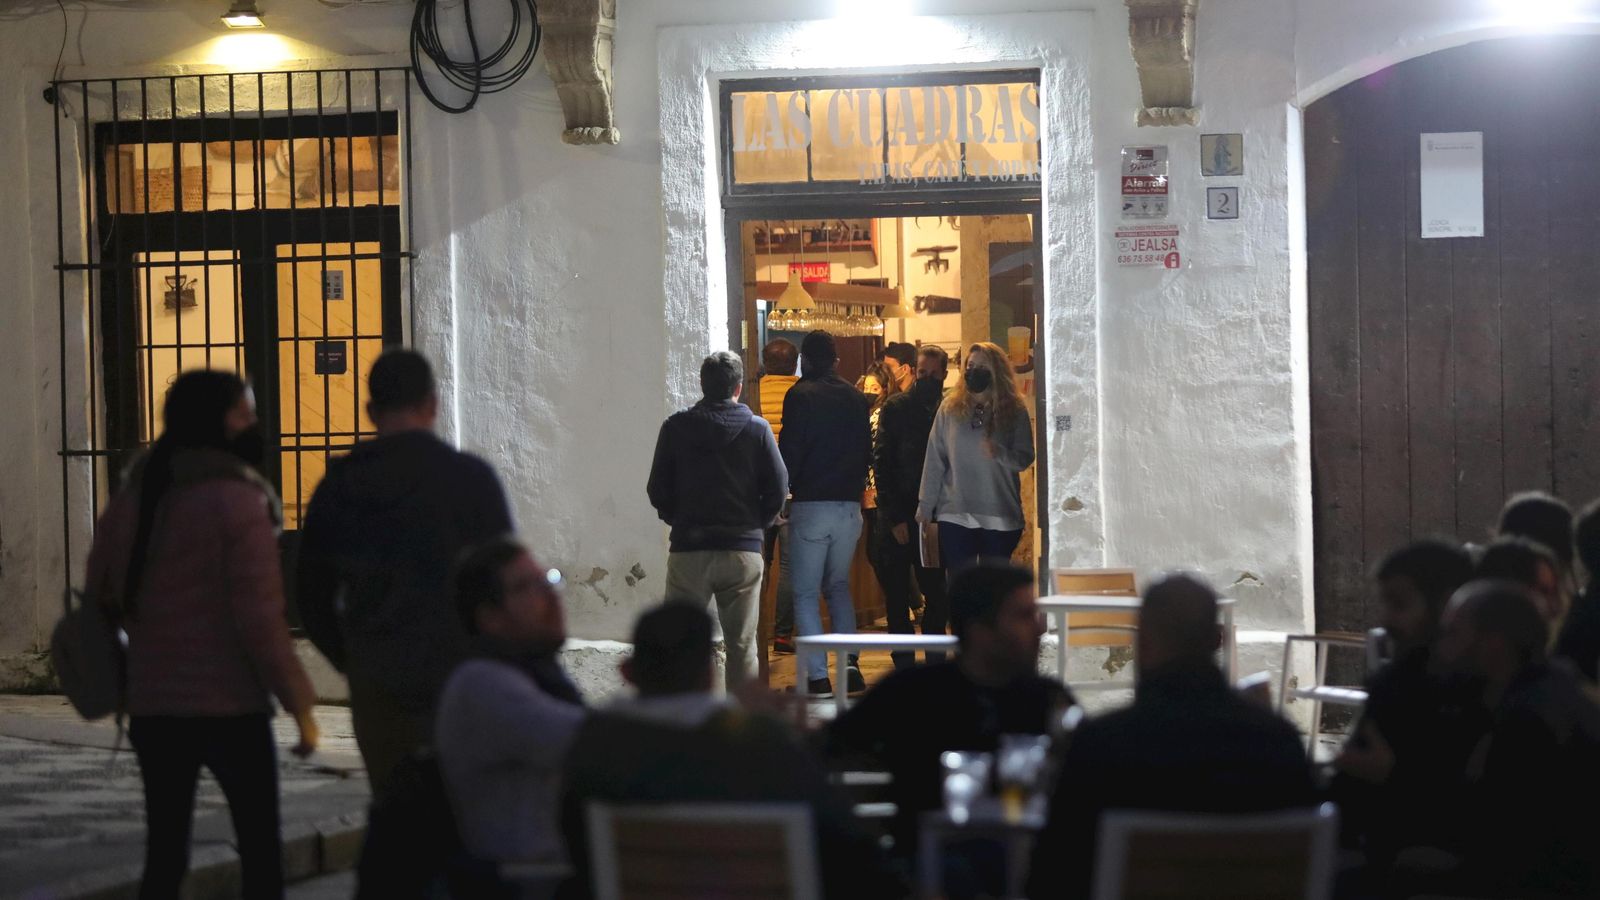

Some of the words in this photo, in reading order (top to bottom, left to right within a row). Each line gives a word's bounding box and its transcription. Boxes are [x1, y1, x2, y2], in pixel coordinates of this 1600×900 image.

[732, 91, 811, 151] LAS
[827, 84, 1041, 148] CUADRAS
[923, 154, 968, 183] CAFÉ
[1124, 178, 1167, 188] Alarma
[1217, 192, 1230, 214] 2
[1131, 238, 1178, 252] JEALSA
[1117, 255, 1131, 264] 636
[1133, 255, 1143, 263] 75
[1145, 254, 1154, 263] 58
[1155, 253, 1165, 262] 48
